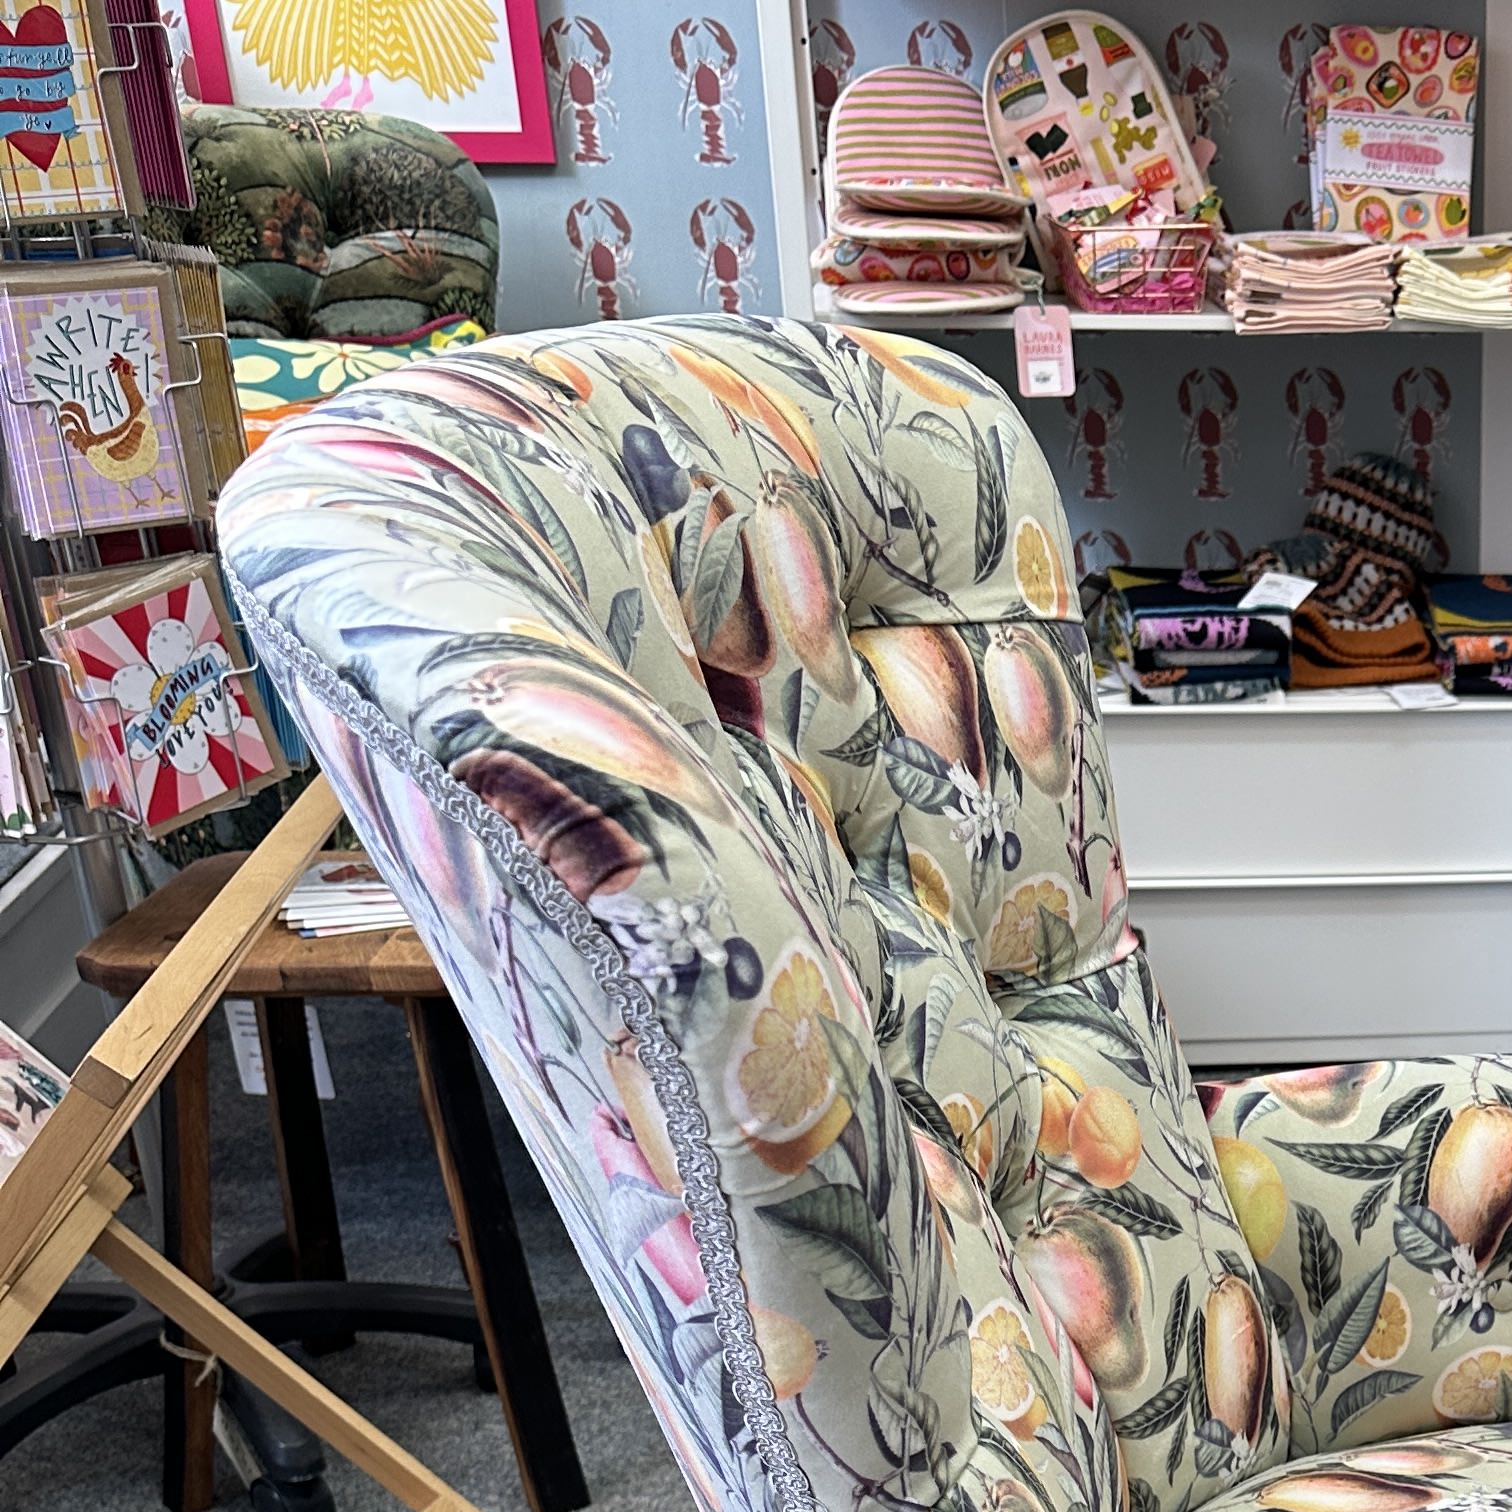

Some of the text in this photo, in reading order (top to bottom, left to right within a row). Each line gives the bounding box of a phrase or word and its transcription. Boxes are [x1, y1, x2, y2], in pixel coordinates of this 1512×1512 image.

[36, 308, 140, 372] WRITE
[33, 373, 70, 402] A
[142, 658, 214, 744] BLOOMING
[156, 718, 196, 769] LOVE
